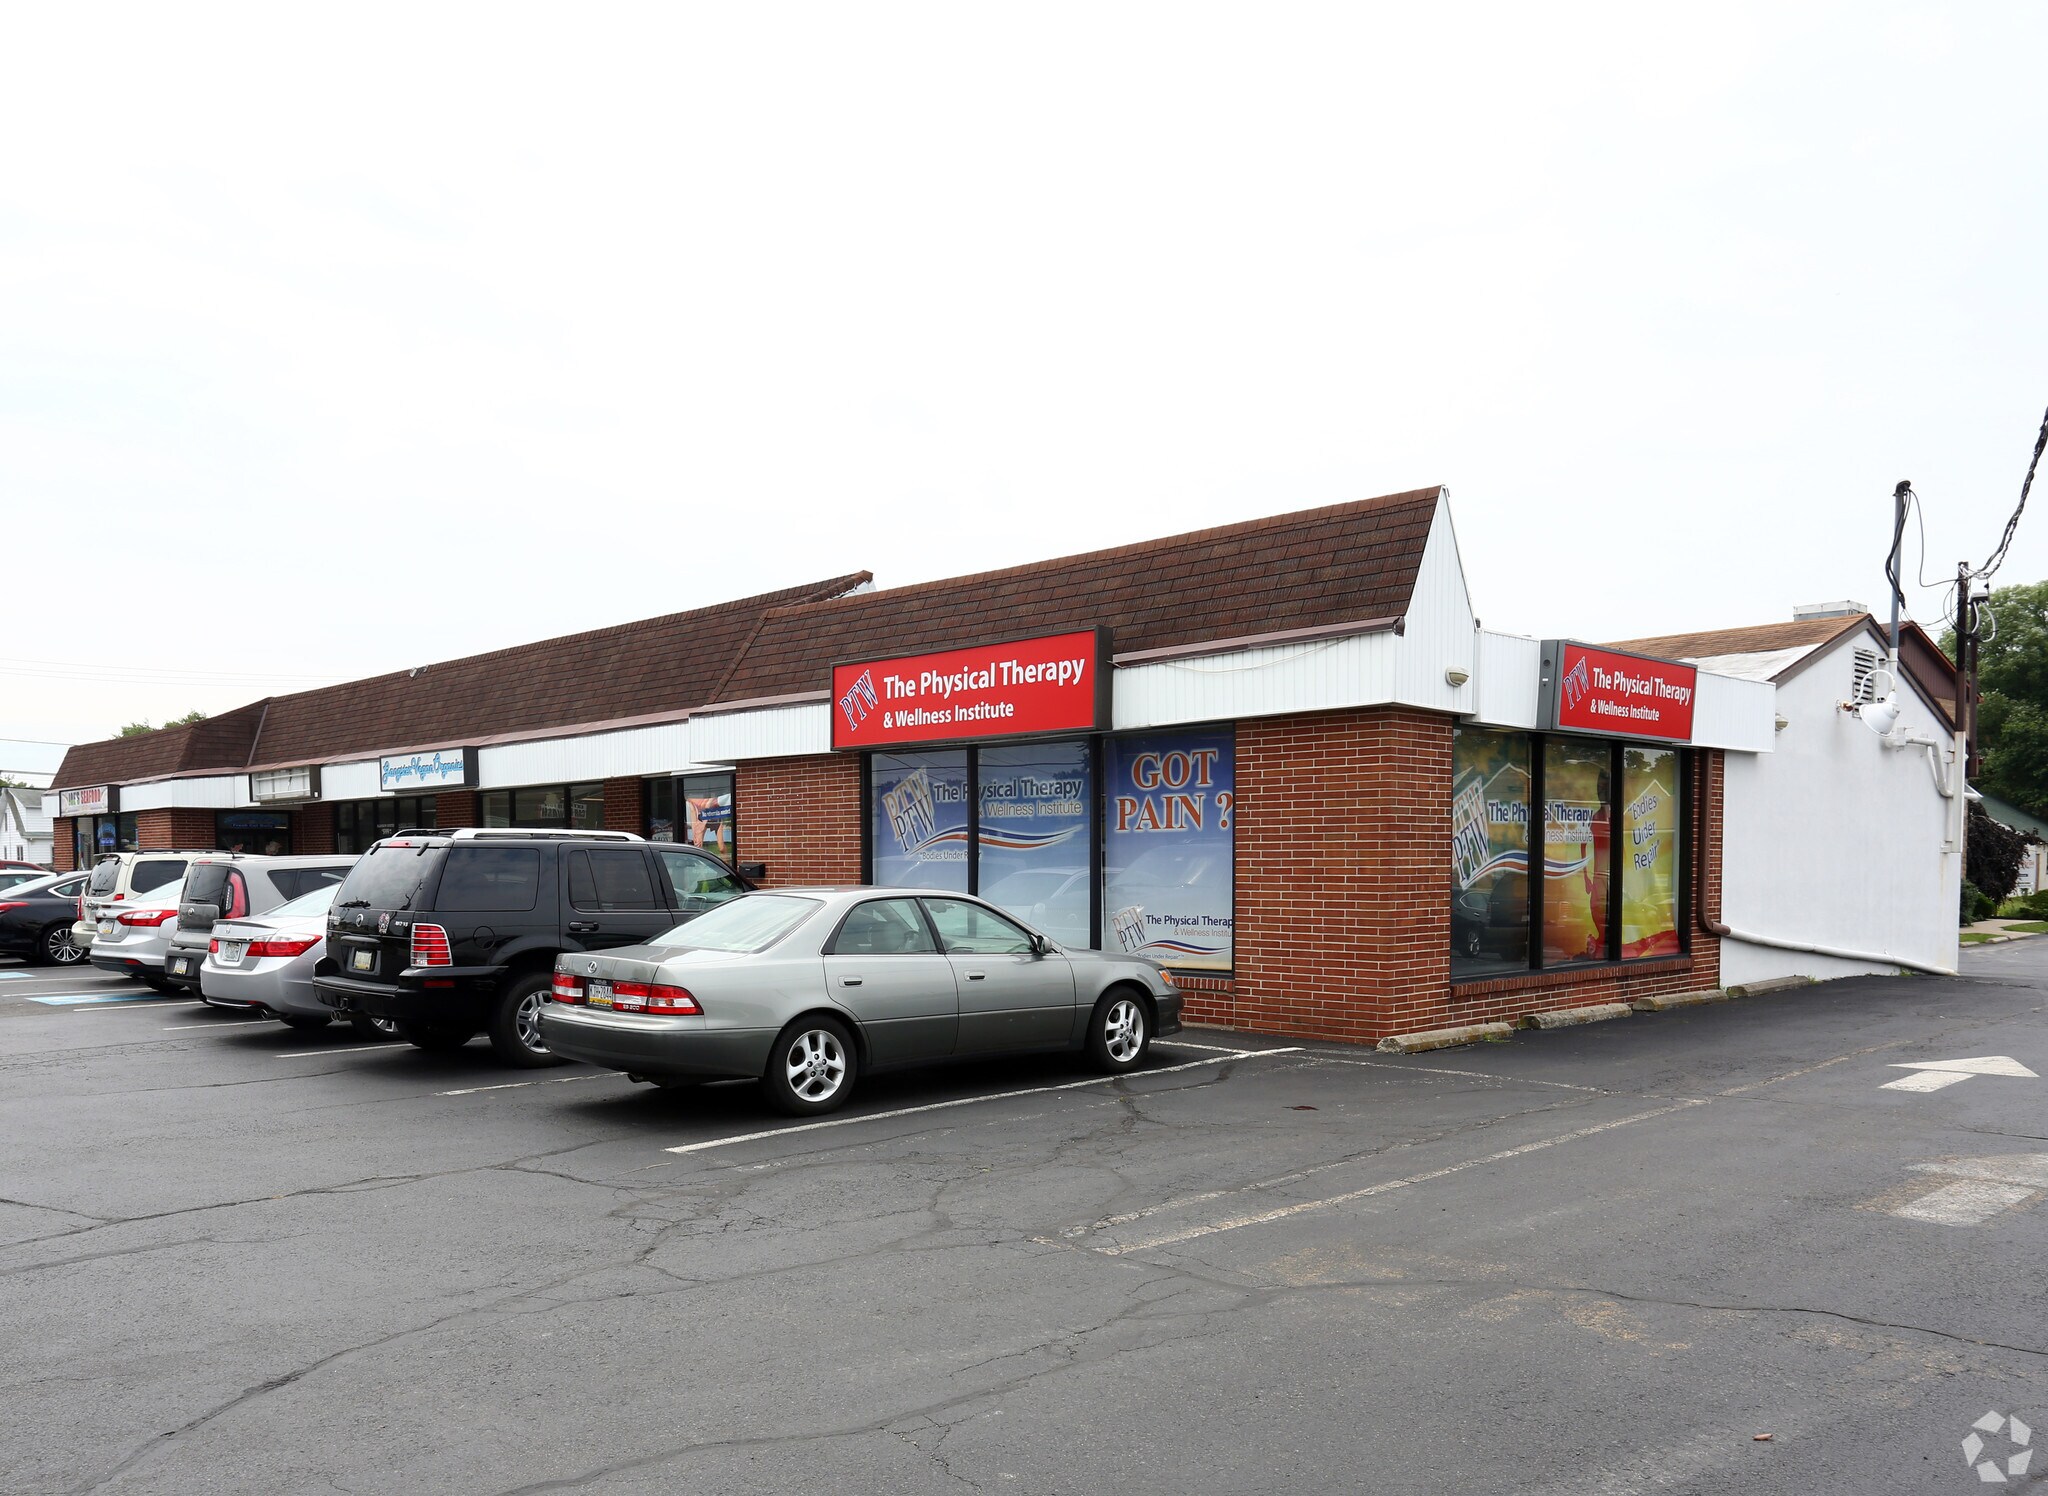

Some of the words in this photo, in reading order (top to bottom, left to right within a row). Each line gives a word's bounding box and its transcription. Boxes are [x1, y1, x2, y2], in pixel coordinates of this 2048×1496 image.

[884, 674, 916, 699] The
[920, 662, 995, 699] Physical
[1000, 658, 1085, 687] Therapy
[1563, 656, 1589, 709] PTW
[1593, 667, 1611, 690] The
[1613, 671, 1653, 697] Physical
[1655, 678, 1691, 706] Therapy
[839, 669, 878, 731] PTW
[1590, 699, 1597, 714] &
[1598, 699, 1629, 717] Wellness
[1630, 704, 1660, 721] Institute
[883, 711, 894, 729] &
[895, 706, 952, 727] Wellness
[955, 701, 1014, 722] Institute
[1133, 750, 1217, 788] GOT
[934, 784, 958, 800] The
[963, 779, 1016, 801] Pysical
[1021, 779, 1082, 799] Therapy
[987, 803, 1034, 816] Wellness
[1037, 801, 1081, 815] Institute
[1115, 793, 1203, 832] PAIN
[1217, 792, 1233, 829] ?
[1489, 802, 1509, 821] The
[1555, 803, 1593, 827] Therapy
[943, 851, 964, 860] Under
[1146, 915, 1162, 925] The
[1164, 915, 1199, 927] Physical
[1181, 928, 1209, 937] Wellness
